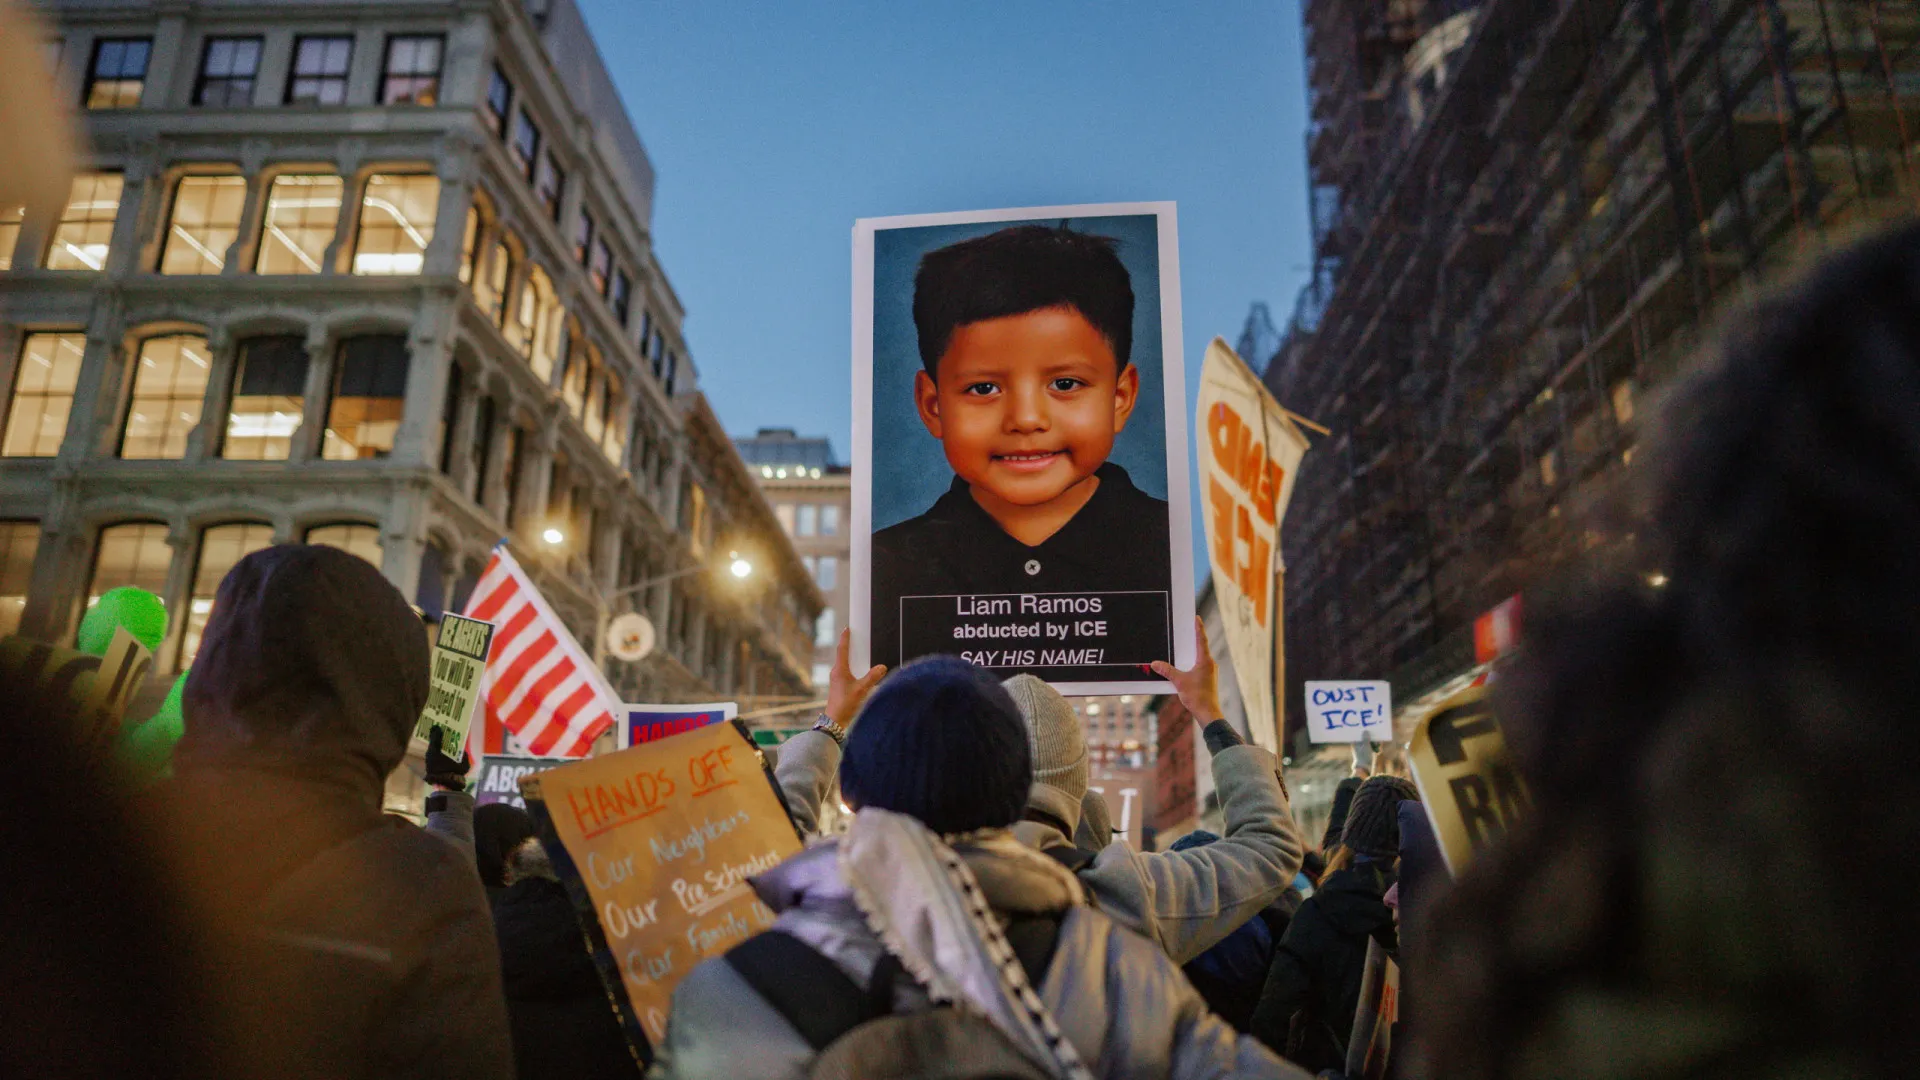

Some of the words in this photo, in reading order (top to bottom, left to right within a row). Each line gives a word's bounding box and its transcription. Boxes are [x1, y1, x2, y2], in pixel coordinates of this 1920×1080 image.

[956, 595, 1012, 616] Liam
[1020, 594, 1102, 615] Ramos
[953, 622, 1040, 640] abducted
[1045, 622, 1070, 641] by
[1074, 620, 1108, 637] ICE
[959, 650, 998, 666] SAY
[1001, 649, 1035, 666] HIS
[1039, 648, 1105, 666] NAME!
[1312, 686, 1375, 706] OUST
[1321, 704, 1384, 731] ICE!
[567, 768, 676, 835] HANDS
[688, 744, 734, 788] OFF
[587, 851, 635, 890] Our
[605, 898, 659, 938] Our
[626, 949, 674, 986] Our
